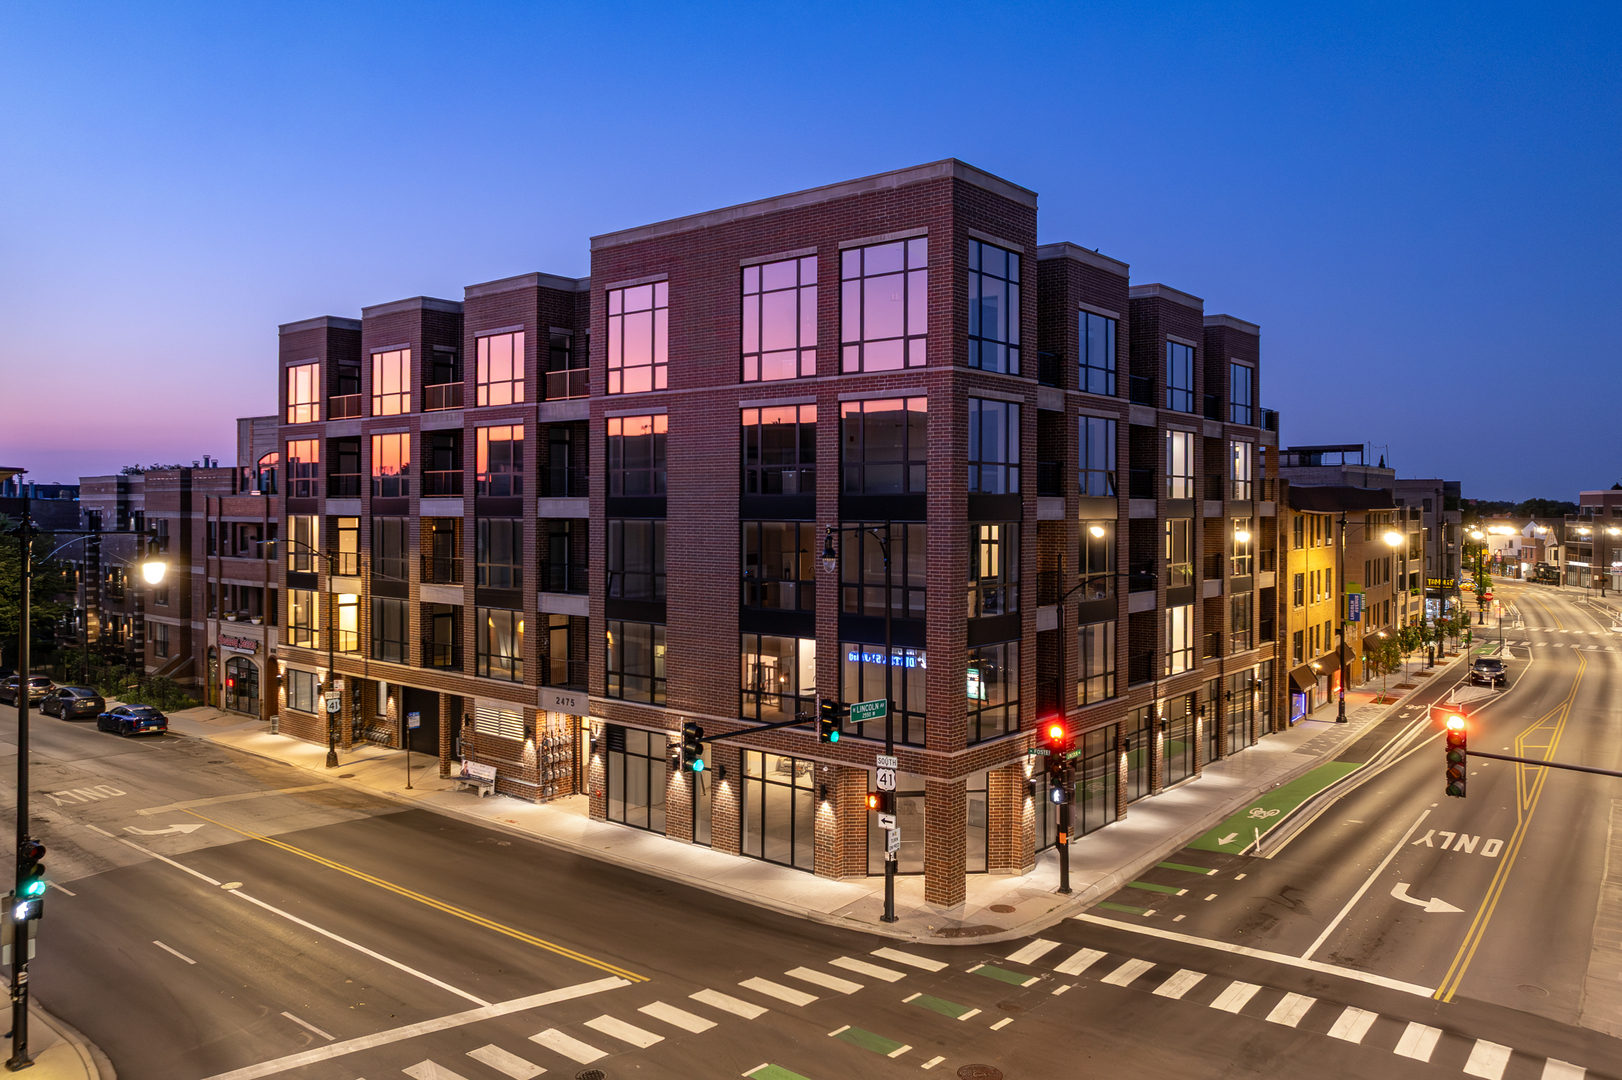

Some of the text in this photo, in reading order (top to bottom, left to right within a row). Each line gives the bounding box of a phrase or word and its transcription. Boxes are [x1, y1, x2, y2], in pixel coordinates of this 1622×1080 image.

[1426, 578, 1454, 586] TAMLES
[328, 702, 338, 710] 41
[555, 696, 575, 707] 2475
[856, 702, 879, 714] LINCOLN
[877, 757, 897, 767] SOUTH
[879, 773, 893, 787] 41
[43, 784, 127, 807] ONLY
[1411, 829, 1504, 858] ONLY
